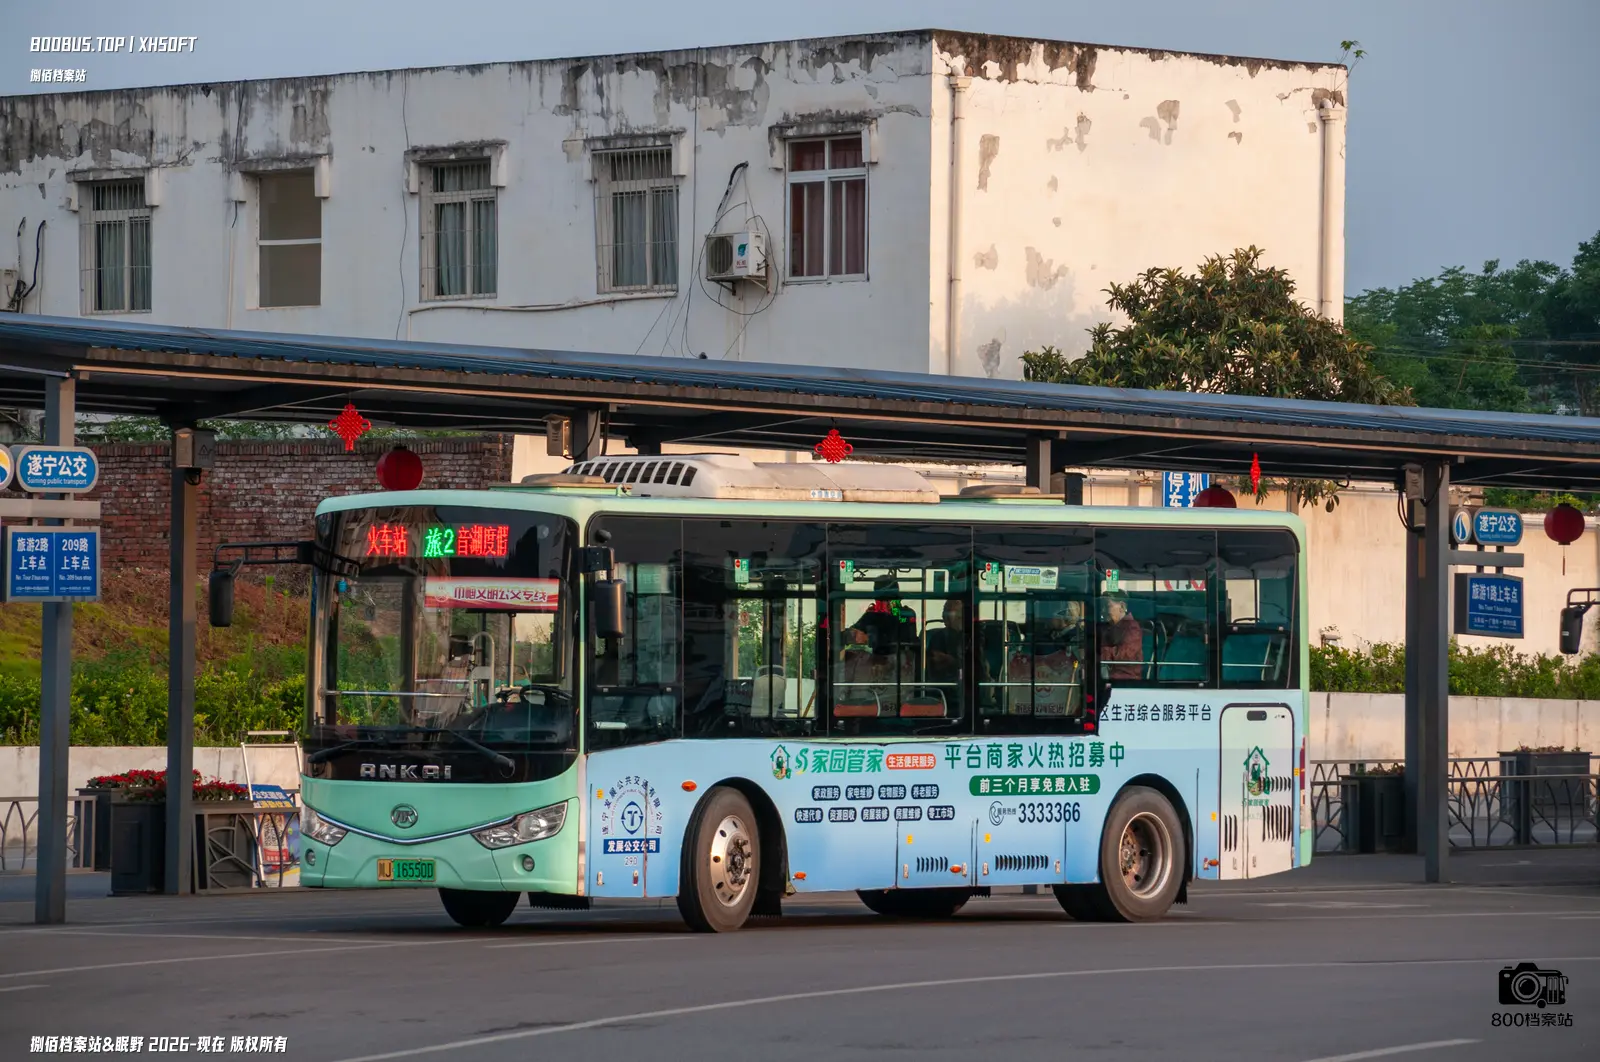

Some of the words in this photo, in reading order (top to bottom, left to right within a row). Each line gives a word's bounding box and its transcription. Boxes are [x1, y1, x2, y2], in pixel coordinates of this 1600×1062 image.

[27, 455, 88, 477] 遂宁公交
[47, 477, 63, 486] public
[63, 477, 87, 486] transport
[1479, 514, 1517, 533] 遂宁公交
[17, 537, 49, 552] 旅游2路
[62, 538, 89, 552] 209路
[366, 525, 408, 557] 火车站
[424, 528, 455, 557] 旅2
[19, 555, 47, 570] 上车点
[61, 555, 91, 570] 上车点
[1472, 583, 1519, 603] 旅游1路上车点
[811, 748, 884, 773] 家园管家
[887, 755, 935, 768] 生活便民服务
[945, 741, 1125, 769] 平台商家火热招募中
[360, 763, 452, 779] ANKAI
[847, 786, 873, 799] 家电维修
[879, 785, 905, 798] 宠物服务
[912, 785, 938, 798] 养老服务
[979, 776, 1091, 794] 前三个月享免费入驻
[813, 786, 840, 800] 家政服务
[829, 808, 856, 821] 资源回收
[862, 808, 889, 821] 房屋装修
[895, 807, 922, 820] 房屋维修
[928, 806, 954, 819] 零工市场
[997, 807, 1016, 815] 服务热线
[1018, 802, 1080, 823] 3333366
[607, 839, 657, 852] 发展公交公司
